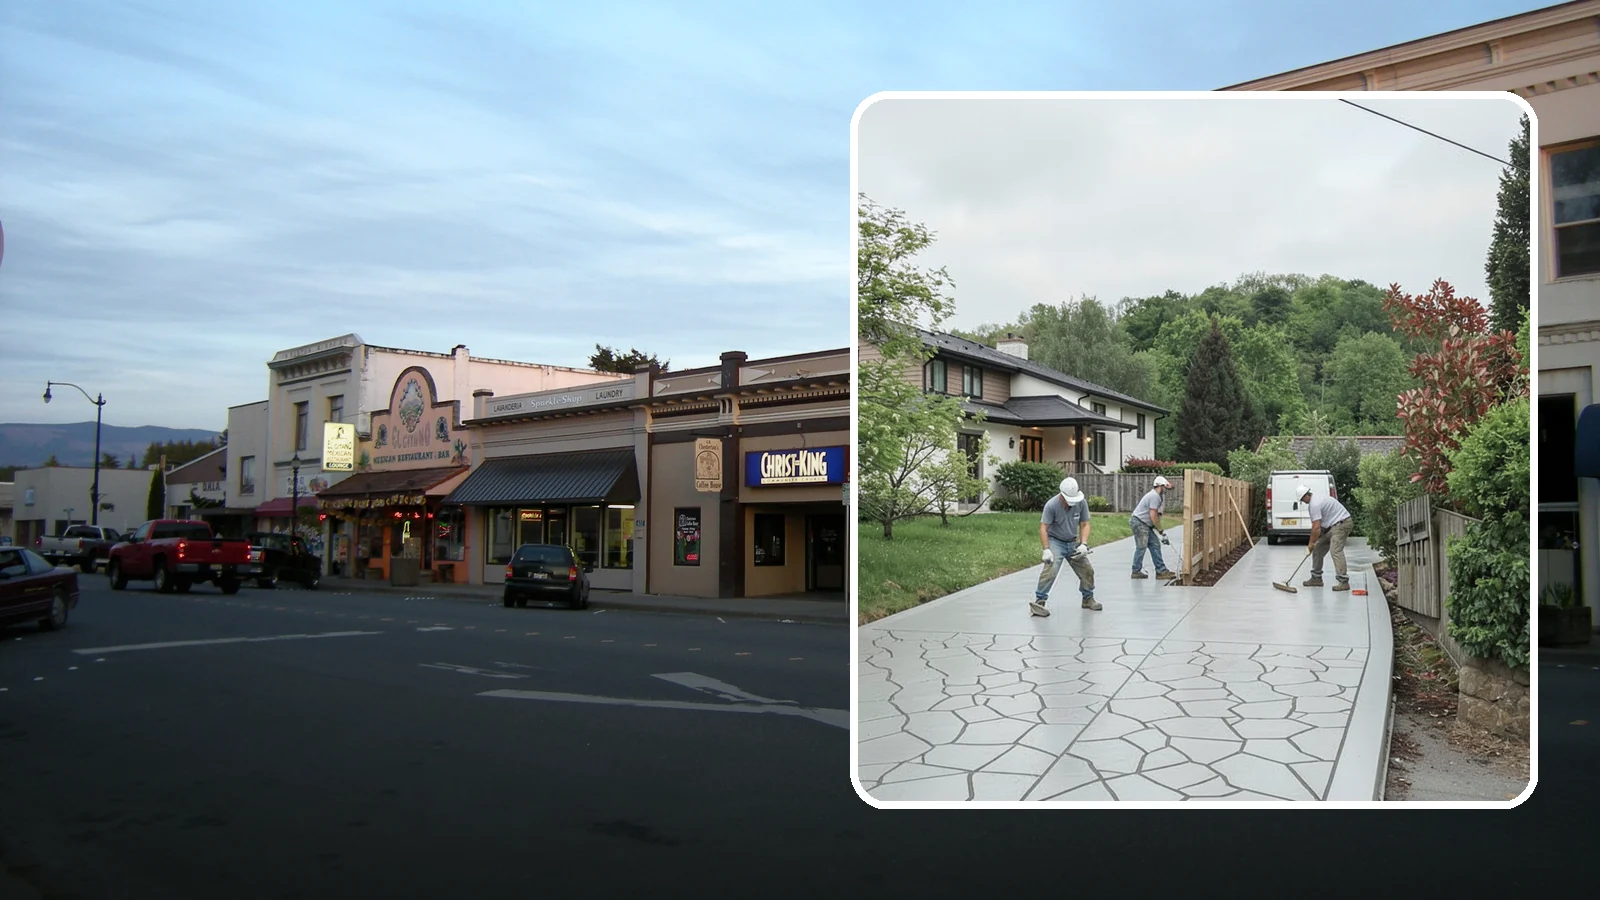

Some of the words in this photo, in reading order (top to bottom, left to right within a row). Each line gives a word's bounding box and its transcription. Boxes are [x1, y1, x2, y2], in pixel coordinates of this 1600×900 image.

[493, 402, 522, 412] LAVANDERIA
[531, 397, 561, 409] Sparkle
[562, 395, 583, 405] Shop
[595, 389, 624, 400] LAUNDRY
[374, 455, 396, 465] MEXICAN
[398, 451, 433, 462] RESTAURANT
[438, 450, 450, 459] BAR
[761, 452, 797, 478] CHRIST
[799, 450, 828, 477] KING
[697, 480, 709, 489] Coffee
[710, 480, 722, 489] House
